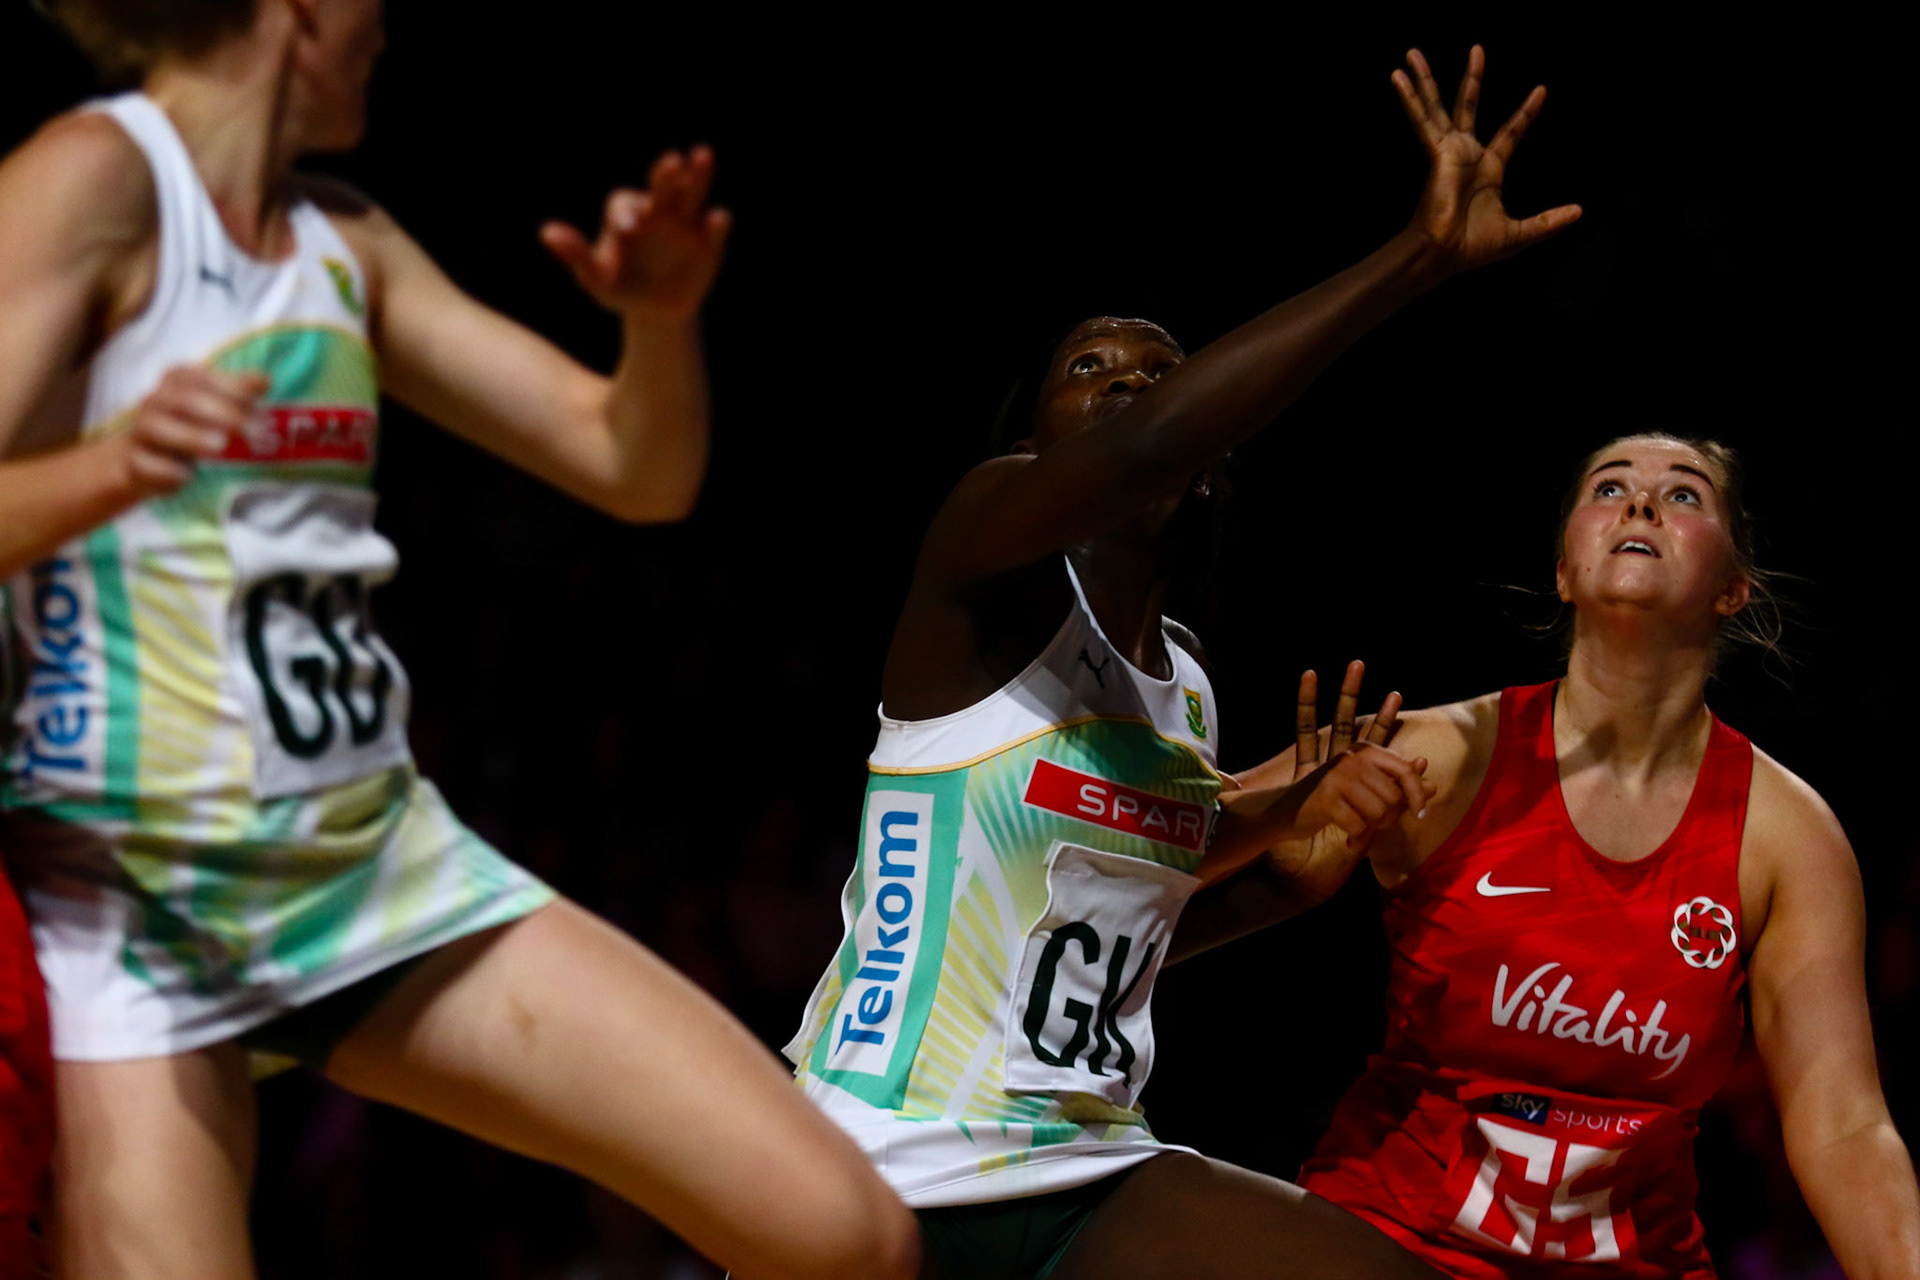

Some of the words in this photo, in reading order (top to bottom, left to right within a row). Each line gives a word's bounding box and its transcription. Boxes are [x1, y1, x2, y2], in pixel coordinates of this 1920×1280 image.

[1076, 783, 1201, 843] SPAR
[836, 810, 918, 1055] Telkom
[1023, 921, 1155, 1088] GK
[1491, 961, 1692, 1081] Vitality
[1500, 1092, 1546, 1121] sky
[1552, 1107, 1643, 1136] sports
[1449, 1116, 1631, 1262] GS
